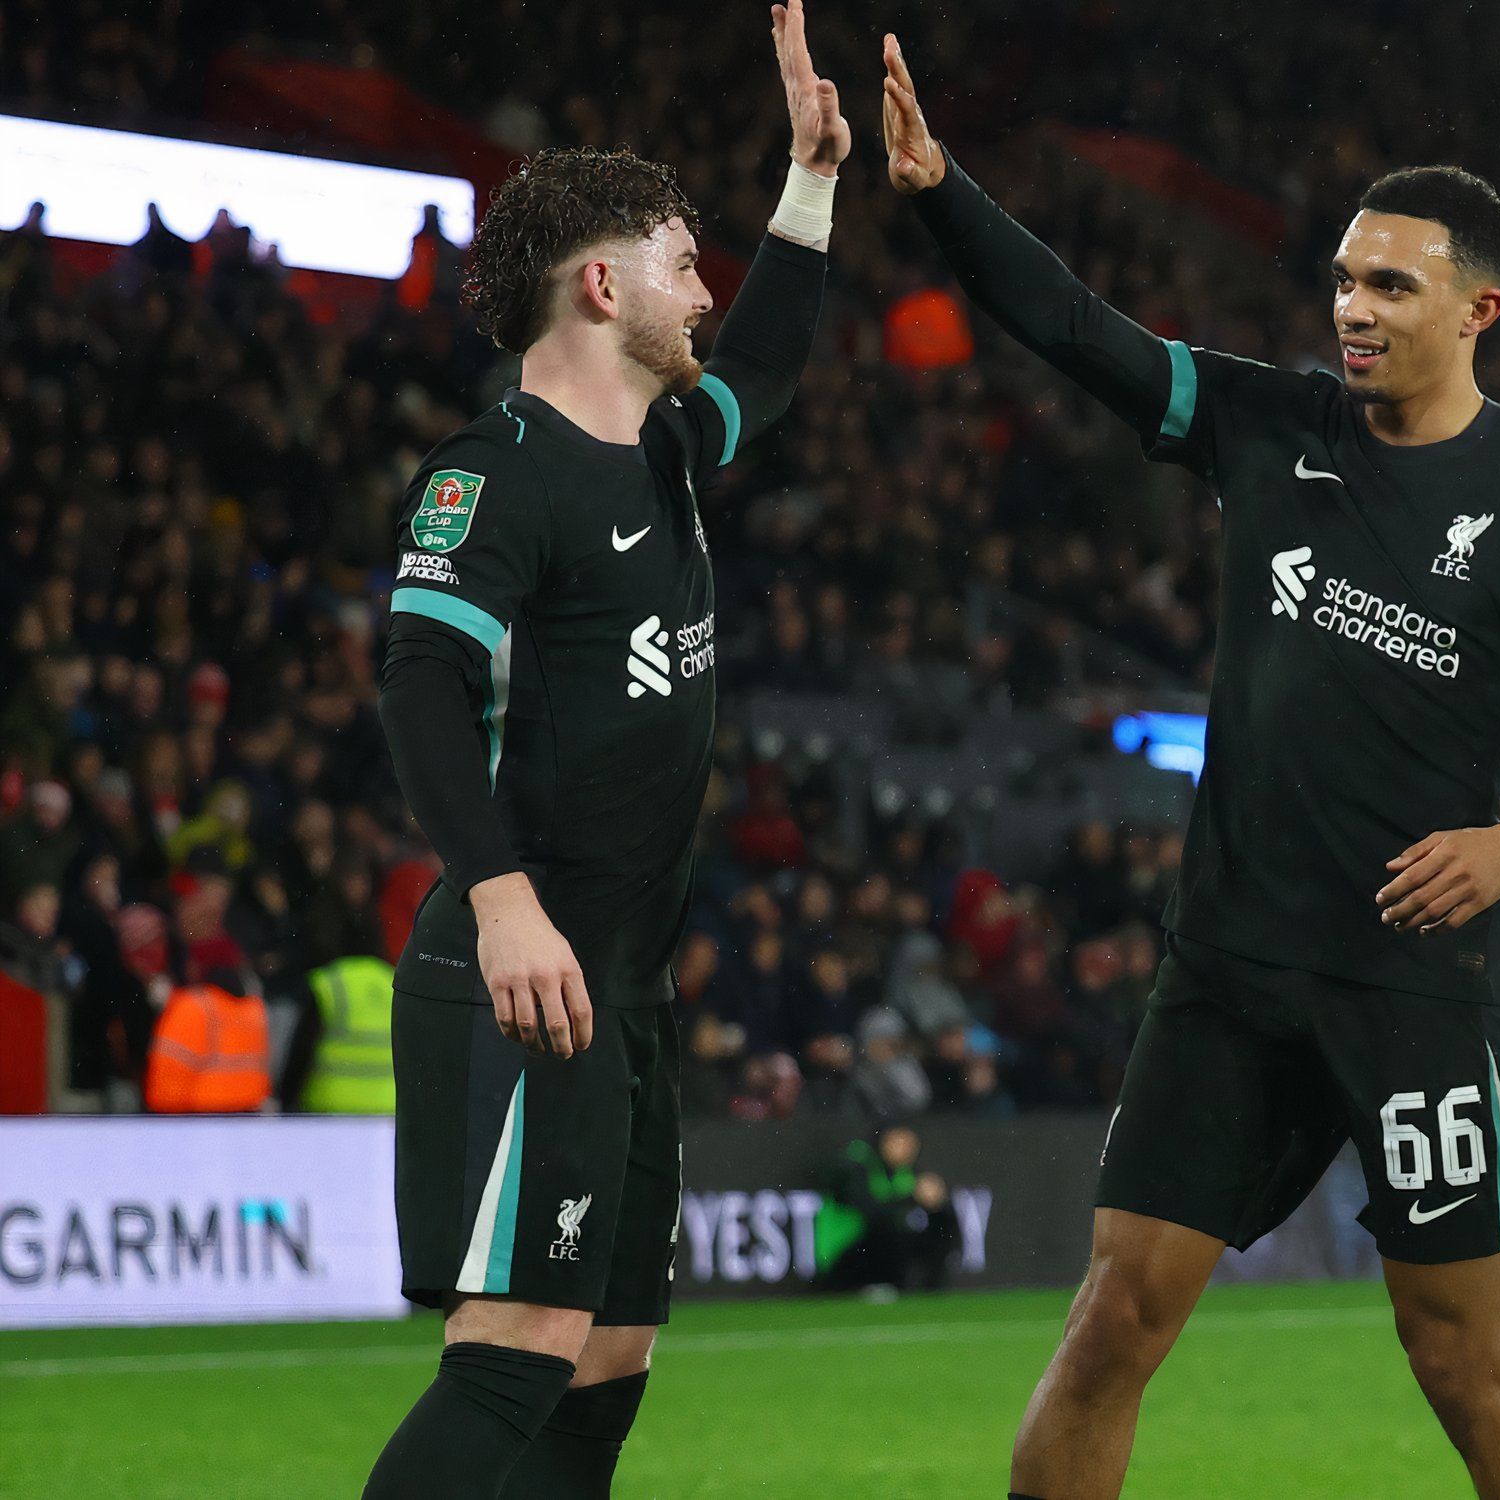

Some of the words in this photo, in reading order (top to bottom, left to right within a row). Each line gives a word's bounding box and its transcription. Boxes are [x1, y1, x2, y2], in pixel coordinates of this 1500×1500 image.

[419, 504, 469, 516] Carabao
[427, 516, 451, 526] Cup
[402, 553, 417, 567] No
[416, 555, 452, 572] room
[1430, 558, 1471, 581] L.F.C.
[410, 566, 460, 585] racism
[1322, 578, 1456, 650] standard
[1313, 604, 1460, 679] chartered
[1380, 1084, 1487, 1190] 66
[0, 1200, 311, 1283] GARMIN
[549, 1244, 580, 1261] L.F.C.
